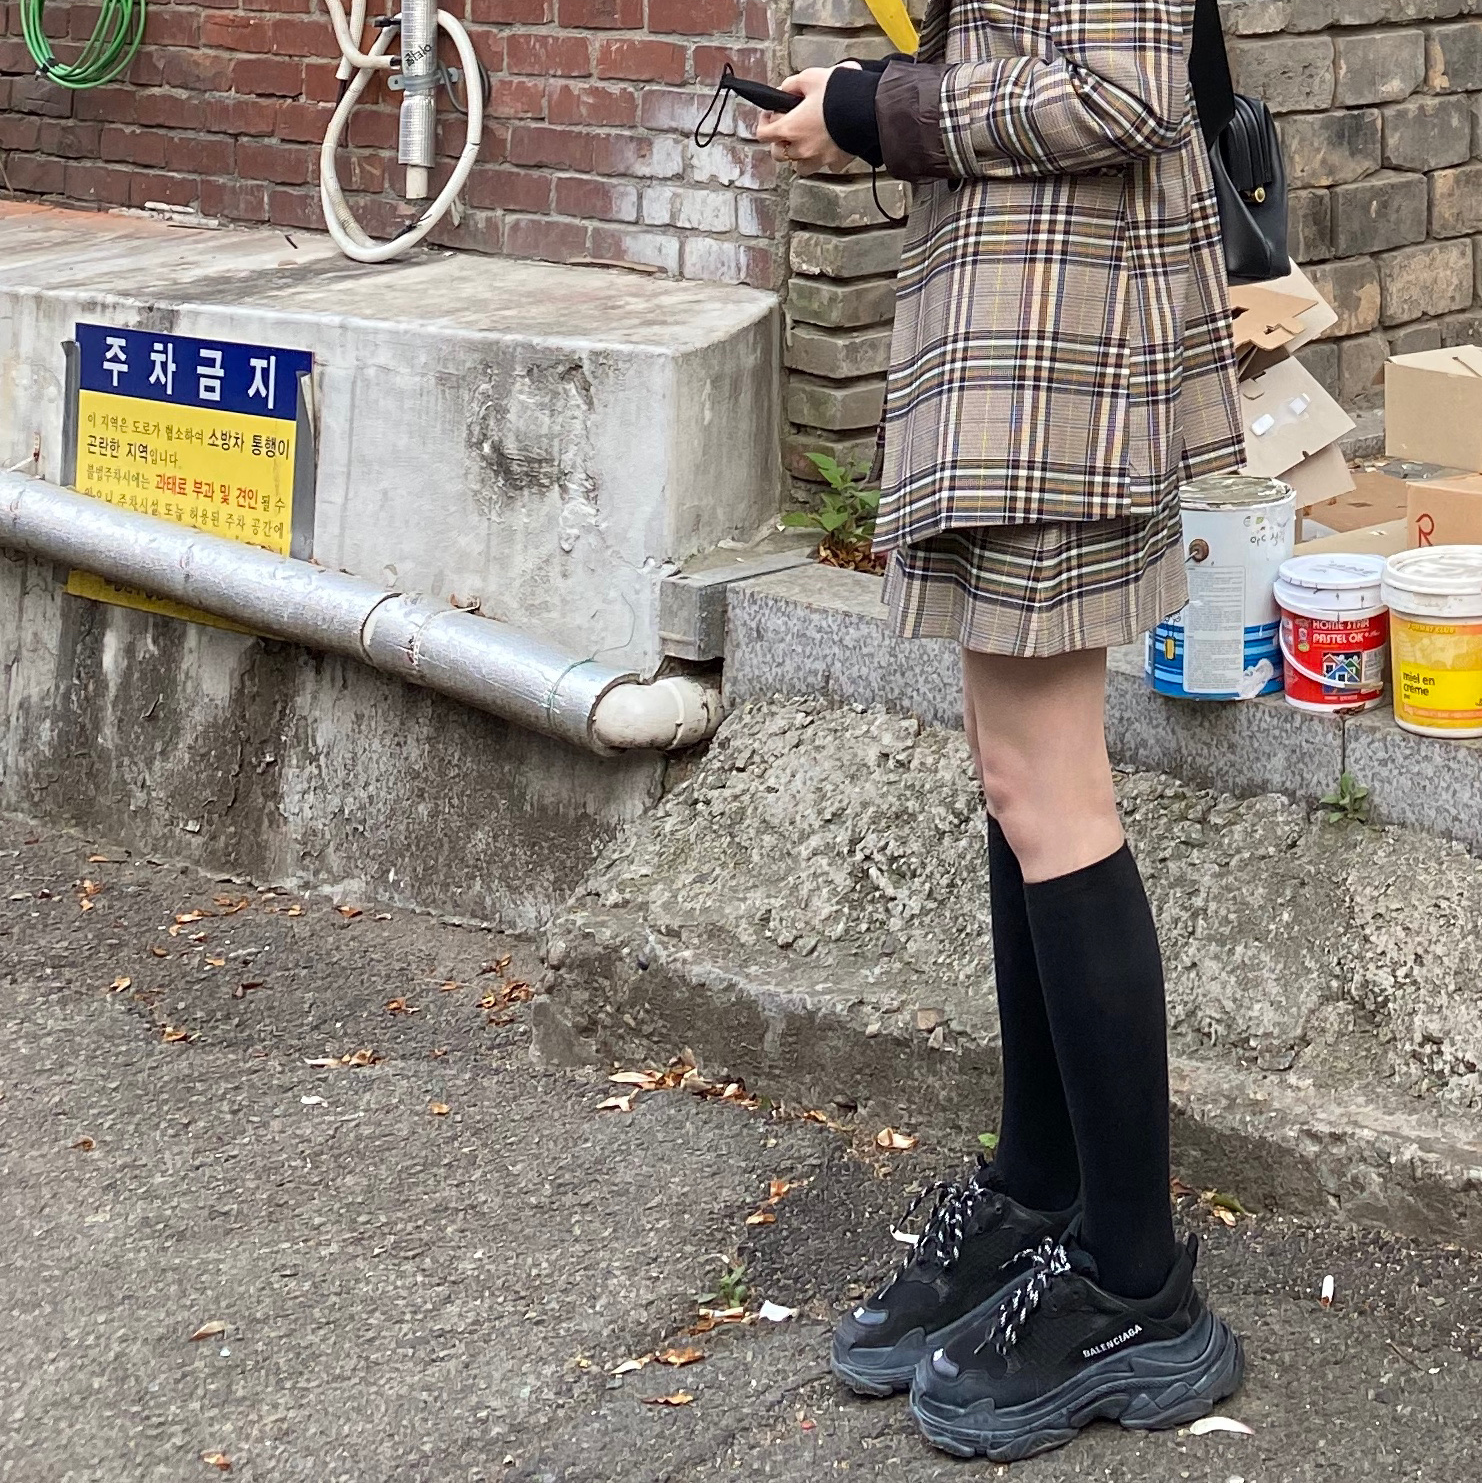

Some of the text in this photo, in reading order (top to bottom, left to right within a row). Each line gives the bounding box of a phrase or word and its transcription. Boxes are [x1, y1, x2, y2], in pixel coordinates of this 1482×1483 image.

[87, 412, 290, 460] 이 지역은 도로가 협소하여 소방차 통행이
[87, 434, 121, 459] 곤란한
[87, 463, 150, 490] 불법주차시에는
[155, 473, 188, 496] 과태료
[192, 478, 215, 502] 부과
[220, 484, 231, 505] 및
[274, 497, 286, 514] 수
[225, 513, 246, 532] 주차
[251, 518, 284, 539] 공간에
[1415, 513, 1435, 548] R
[1312, 633, 1347, 644] PASTEL
[1423, 677, 1435, 686] en
[1082, 1324, 1143, 1358] BALENCIAGA
